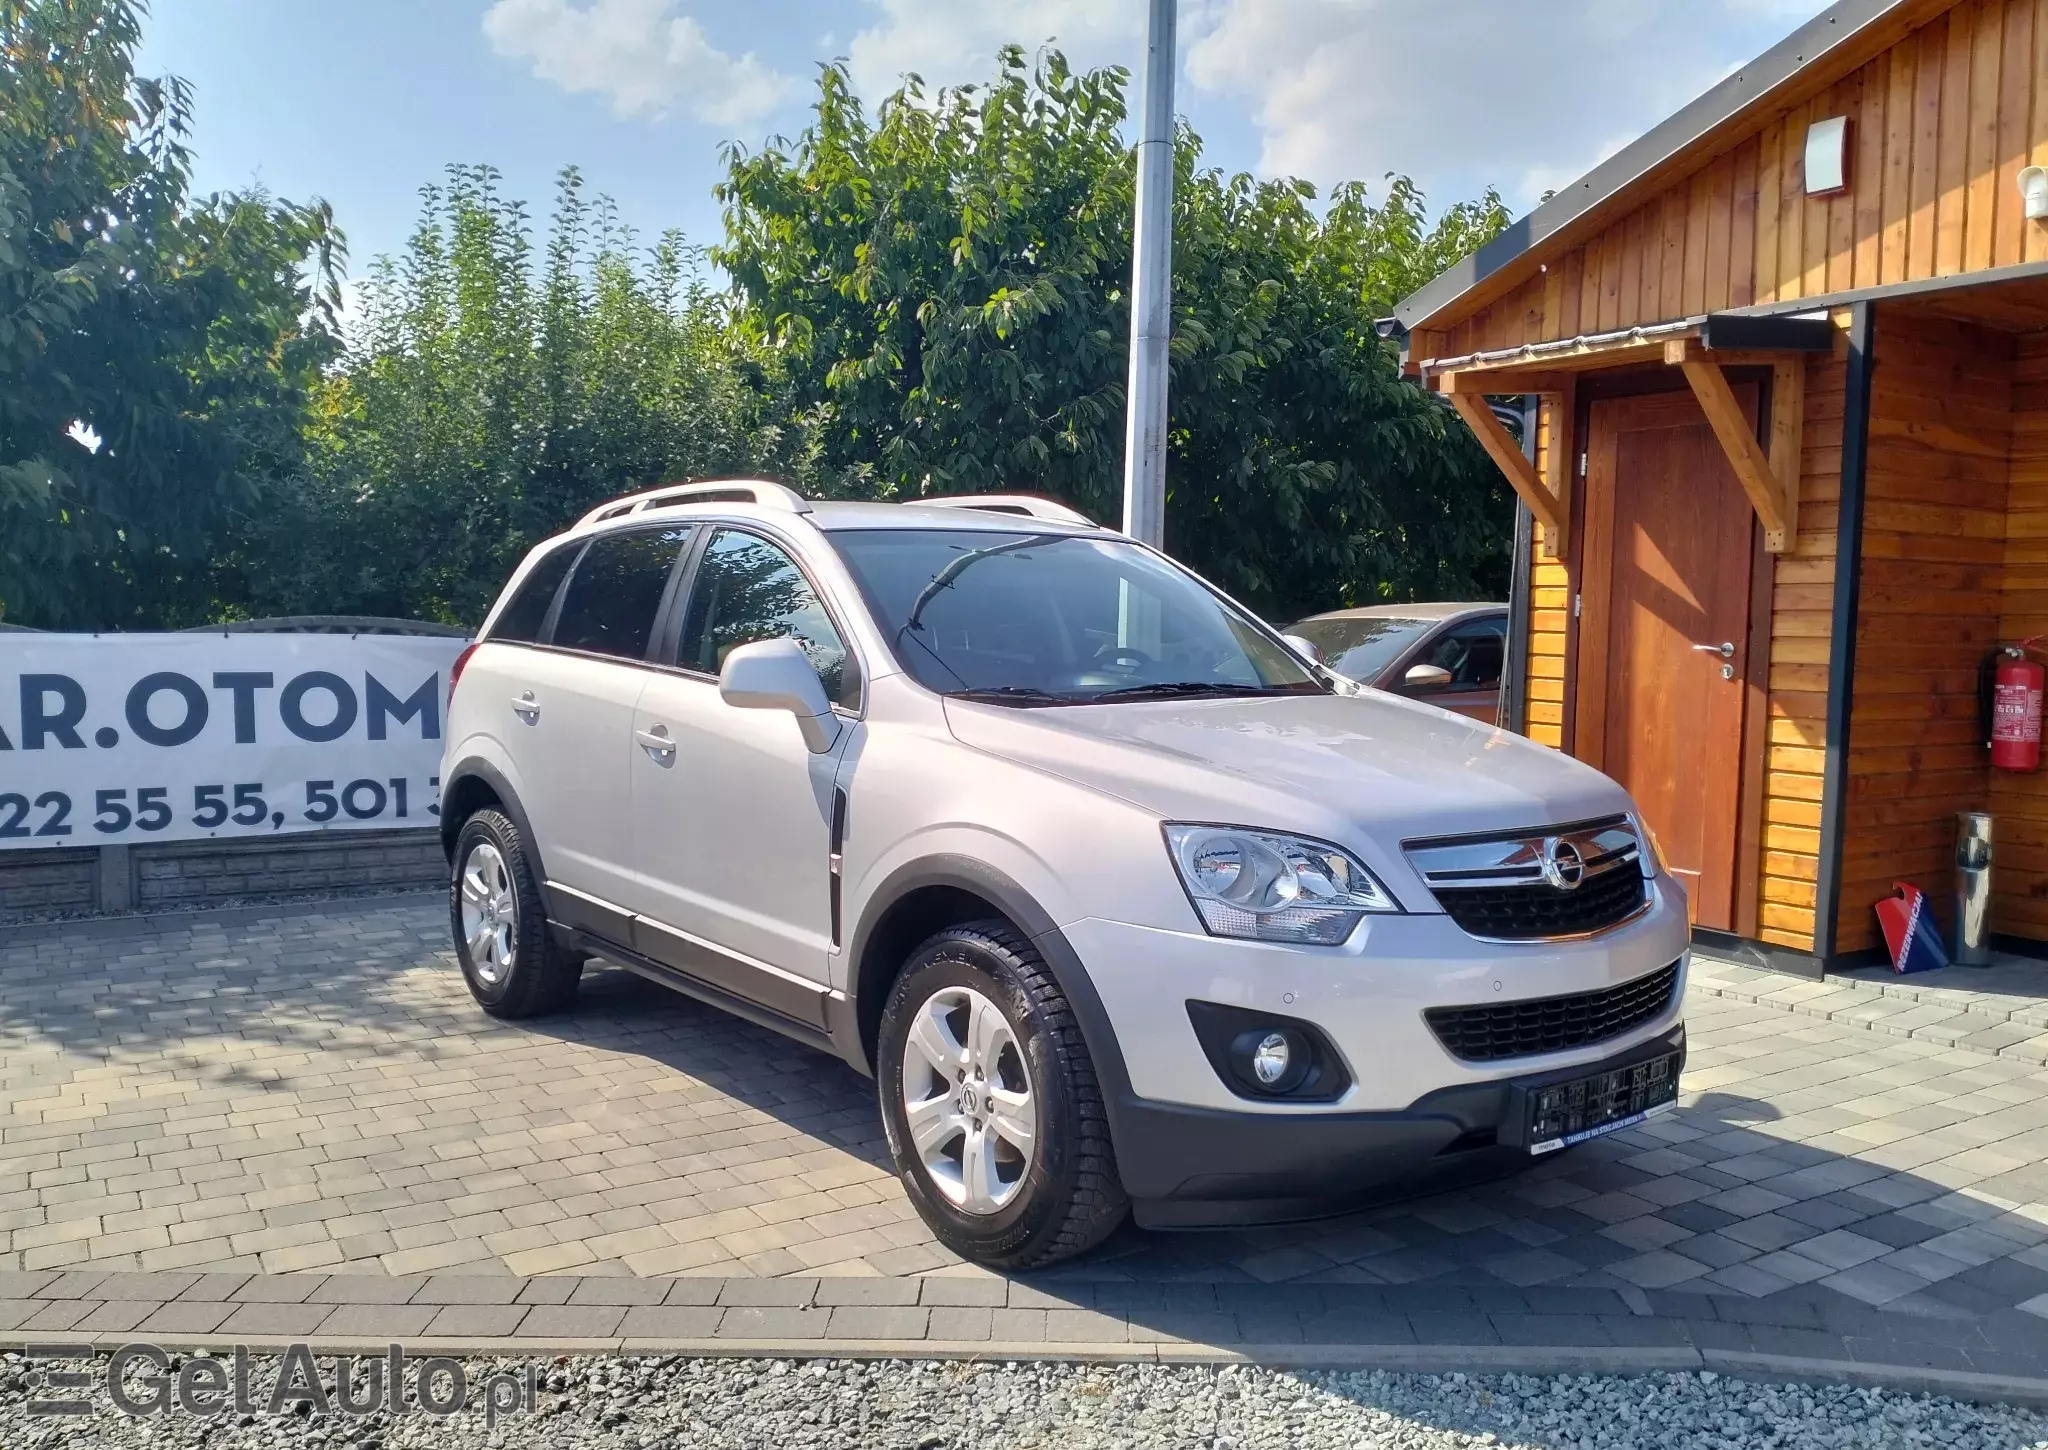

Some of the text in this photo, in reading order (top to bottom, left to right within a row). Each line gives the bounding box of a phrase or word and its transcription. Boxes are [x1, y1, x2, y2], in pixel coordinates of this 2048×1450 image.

[0, 671, 441, 750] R.OTOM
[92, 787, 173, 833] 55
[191, 783, 285, 830] 55,
[303, 777, 407, 822] 501
